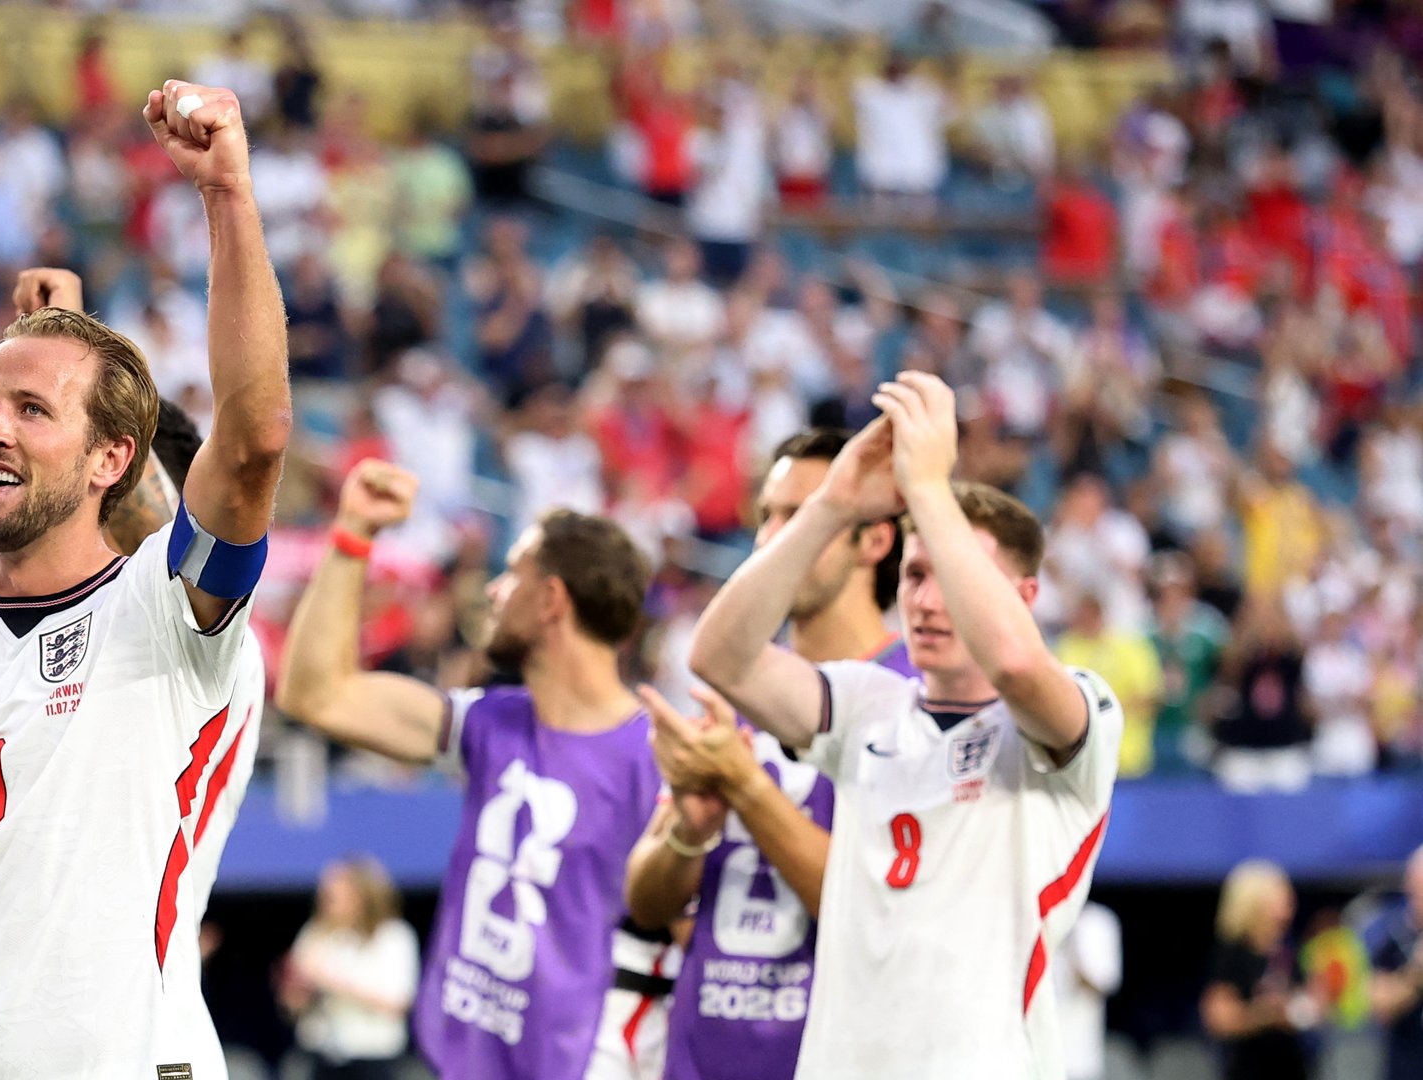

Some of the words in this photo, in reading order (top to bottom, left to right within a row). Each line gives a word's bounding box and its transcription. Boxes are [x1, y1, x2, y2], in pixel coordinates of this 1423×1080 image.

[49, 682, 84, 700] ORWAY
[885, 812, 922, 889] 8
[698, 982, 808, 1021] 2026
